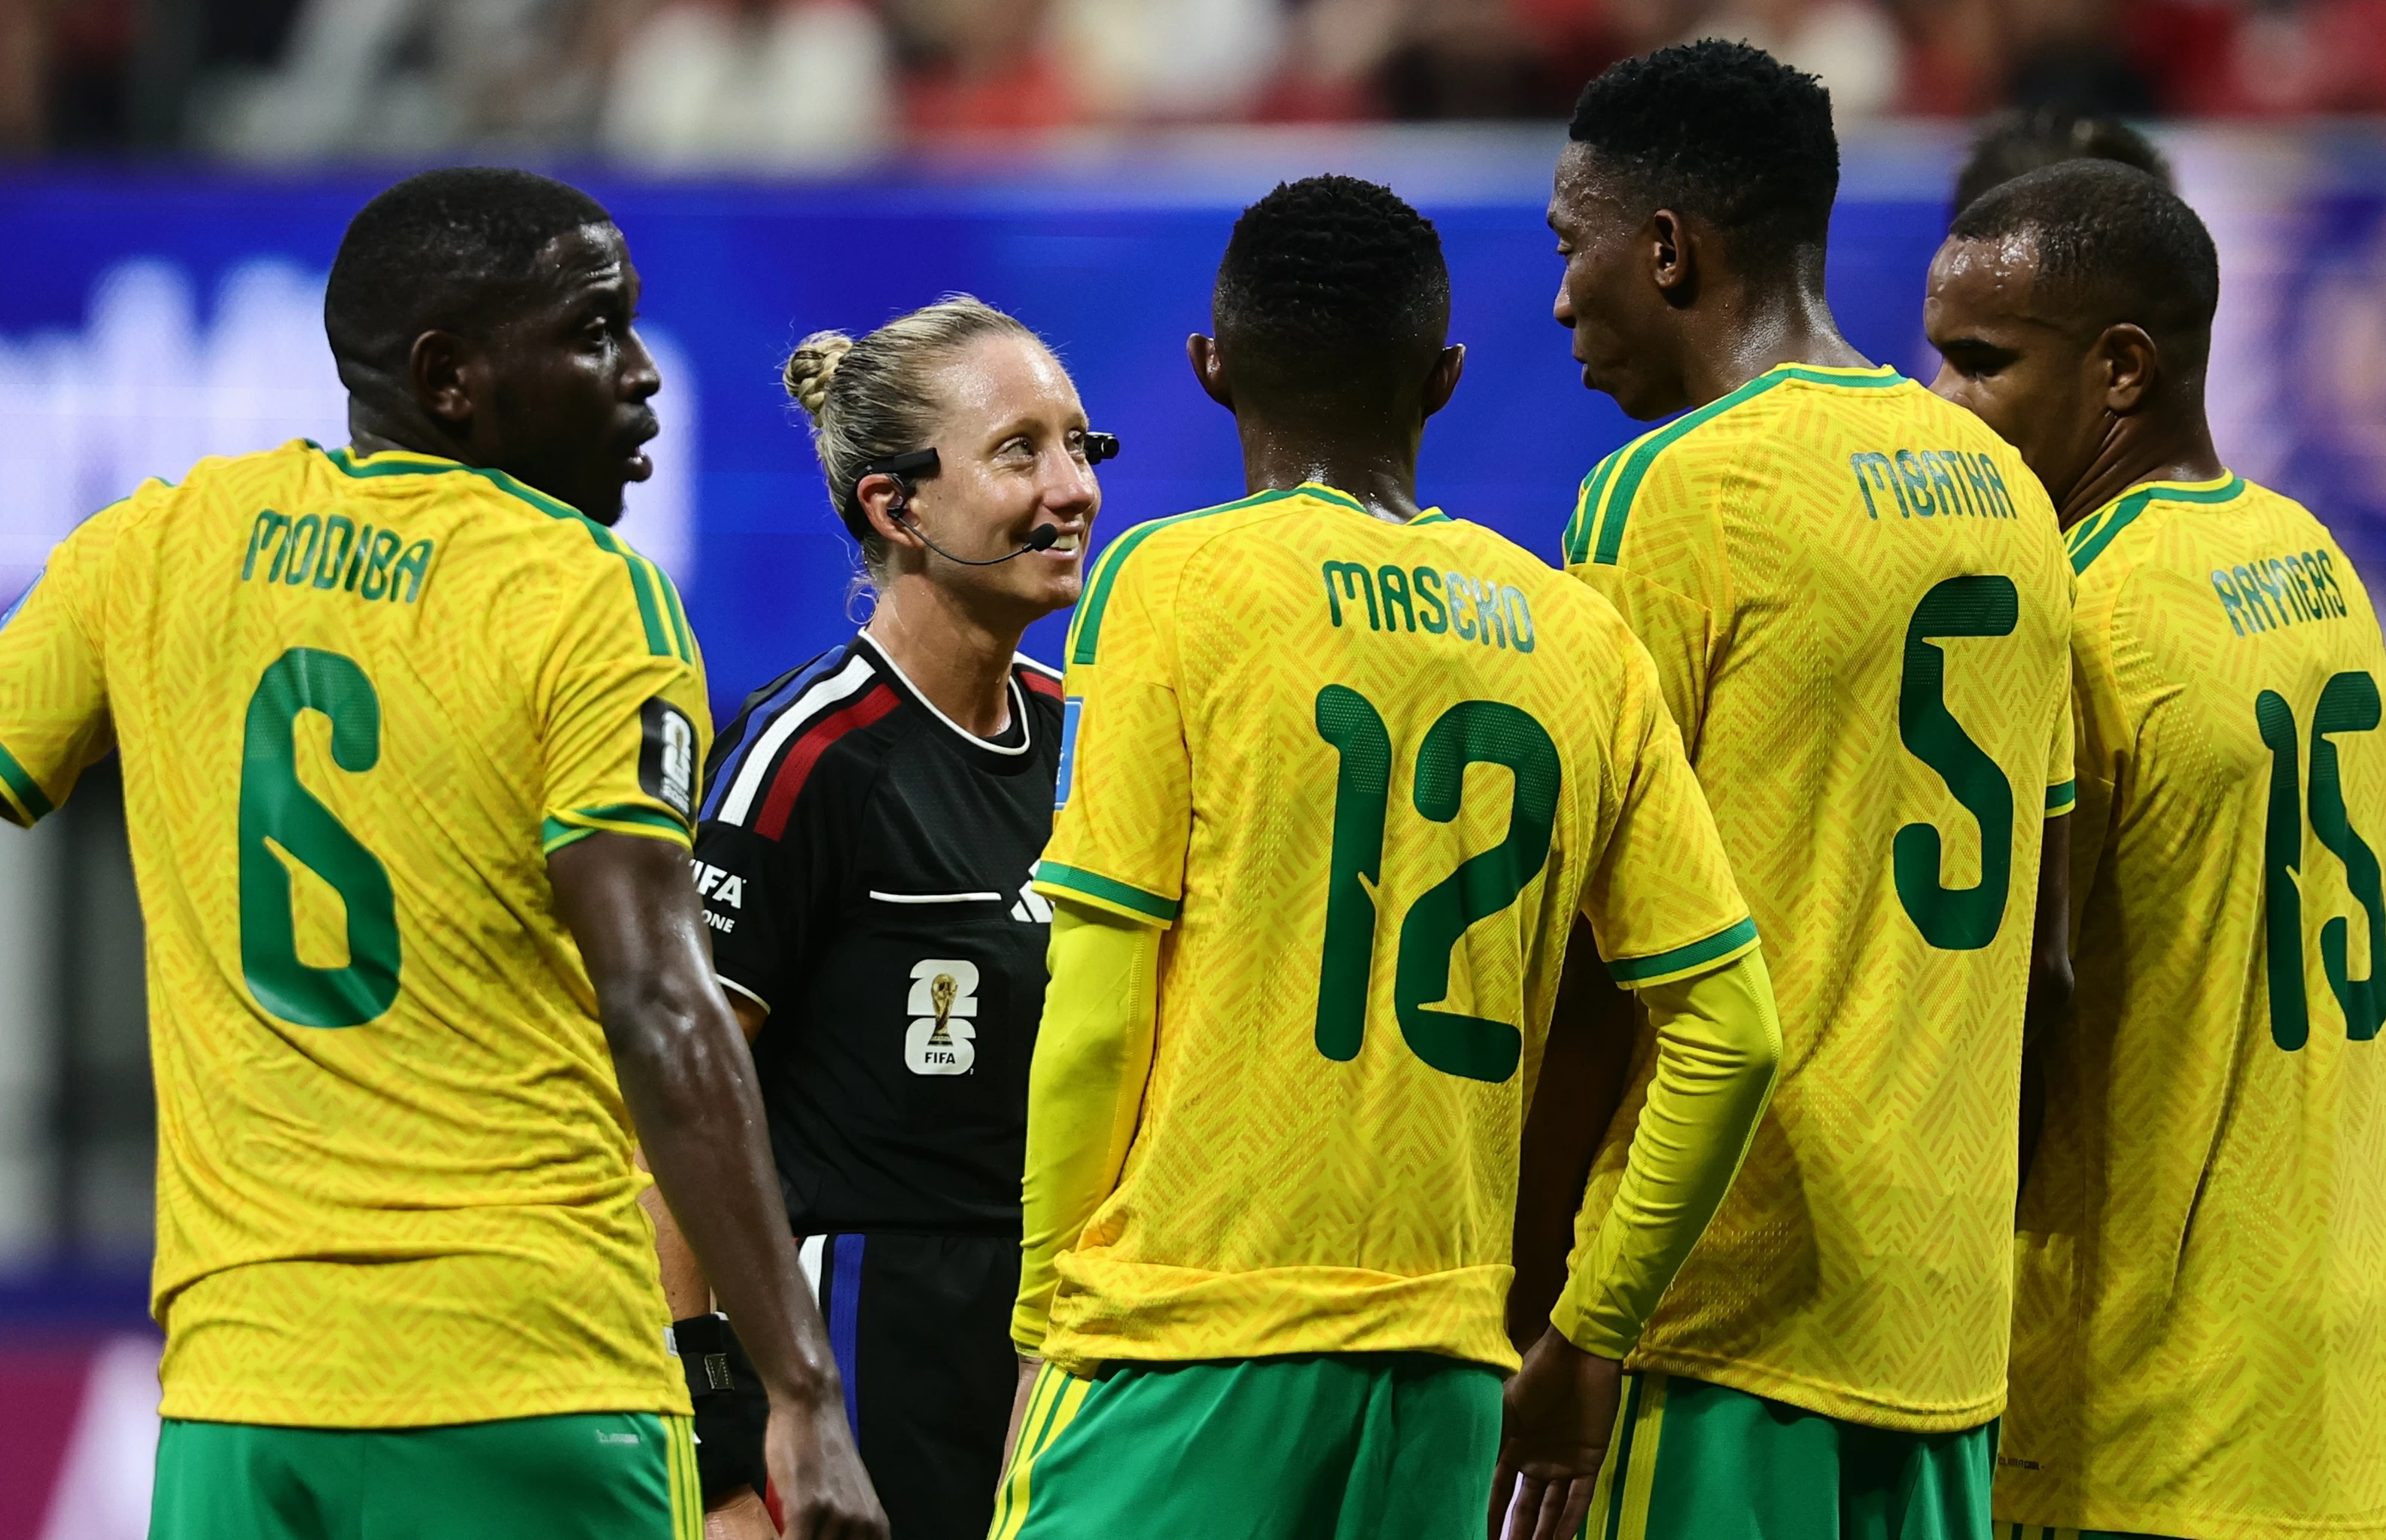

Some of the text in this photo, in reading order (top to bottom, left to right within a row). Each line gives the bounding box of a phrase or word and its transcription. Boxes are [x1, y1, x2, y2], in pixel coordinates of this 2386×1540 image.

[1849, 449, 2018, 520] MBATHA
[242, 509, 434, 604] MODIBA
[2211, 549, 2347, 638] RAYNERS
[1322, 560, 1535, 653] MASEKO
[1893, 575, 2019, 950] 5
[239, 647, 401, 1029] 6
[688, 859, 742, 909] IFA
[1315, 683, 1562, 1083] 12
[2256, 671, 2386, 1051] 15
[924, 1052, 956, 1064] FIFA
